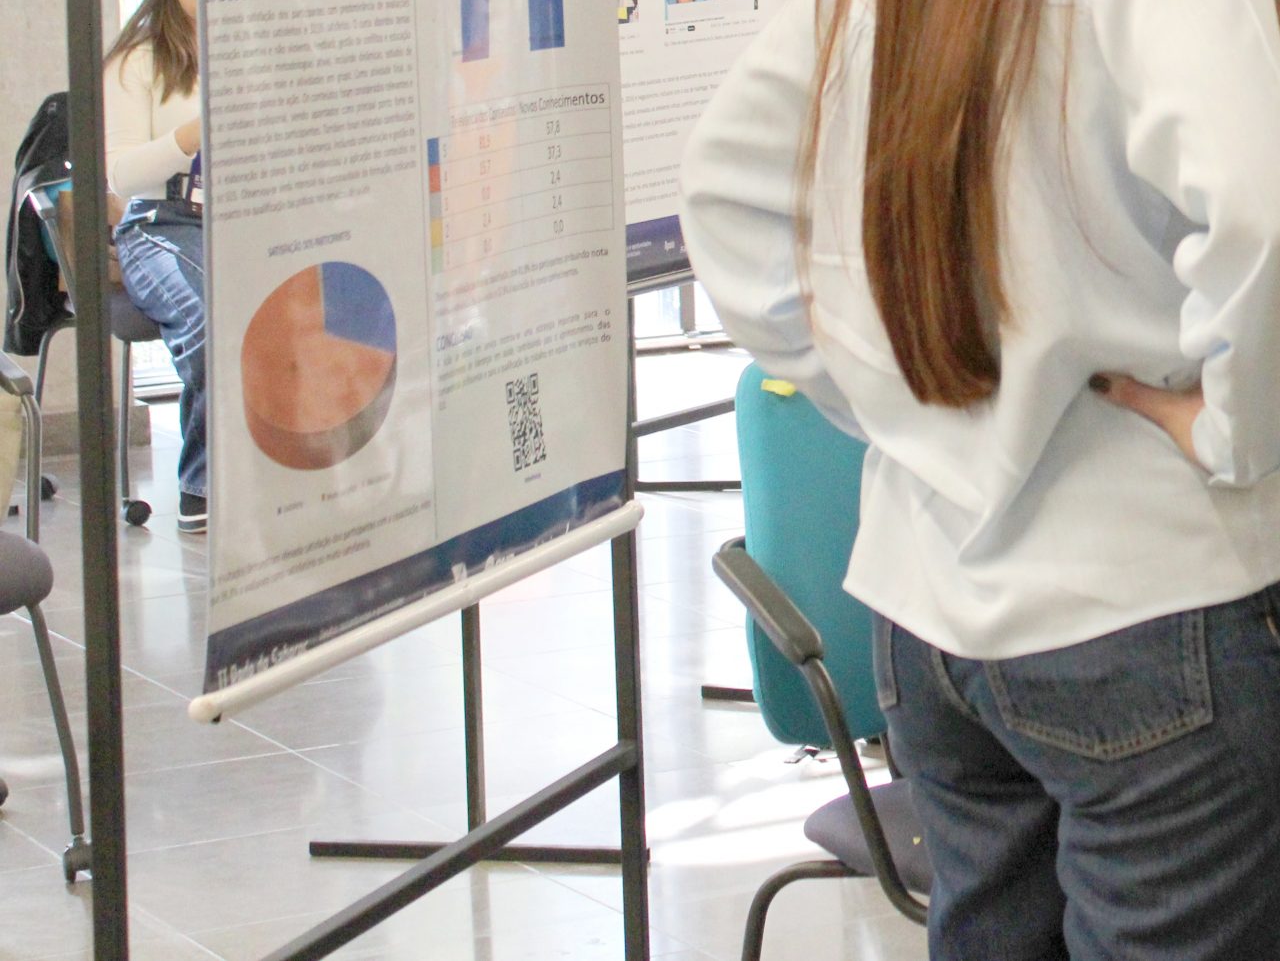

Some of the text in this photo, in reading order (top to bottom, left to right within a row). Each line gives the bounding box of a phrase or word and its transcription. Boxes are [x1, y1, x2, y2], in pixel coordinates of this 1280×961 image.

[538, 91, 606, 113] Conhecimentos
[550, 169, 561, 185] 2,4
[591, 248, 610, 260] nota
[597, 320, 612, 331] das
[600, 333, 612, 344] do
